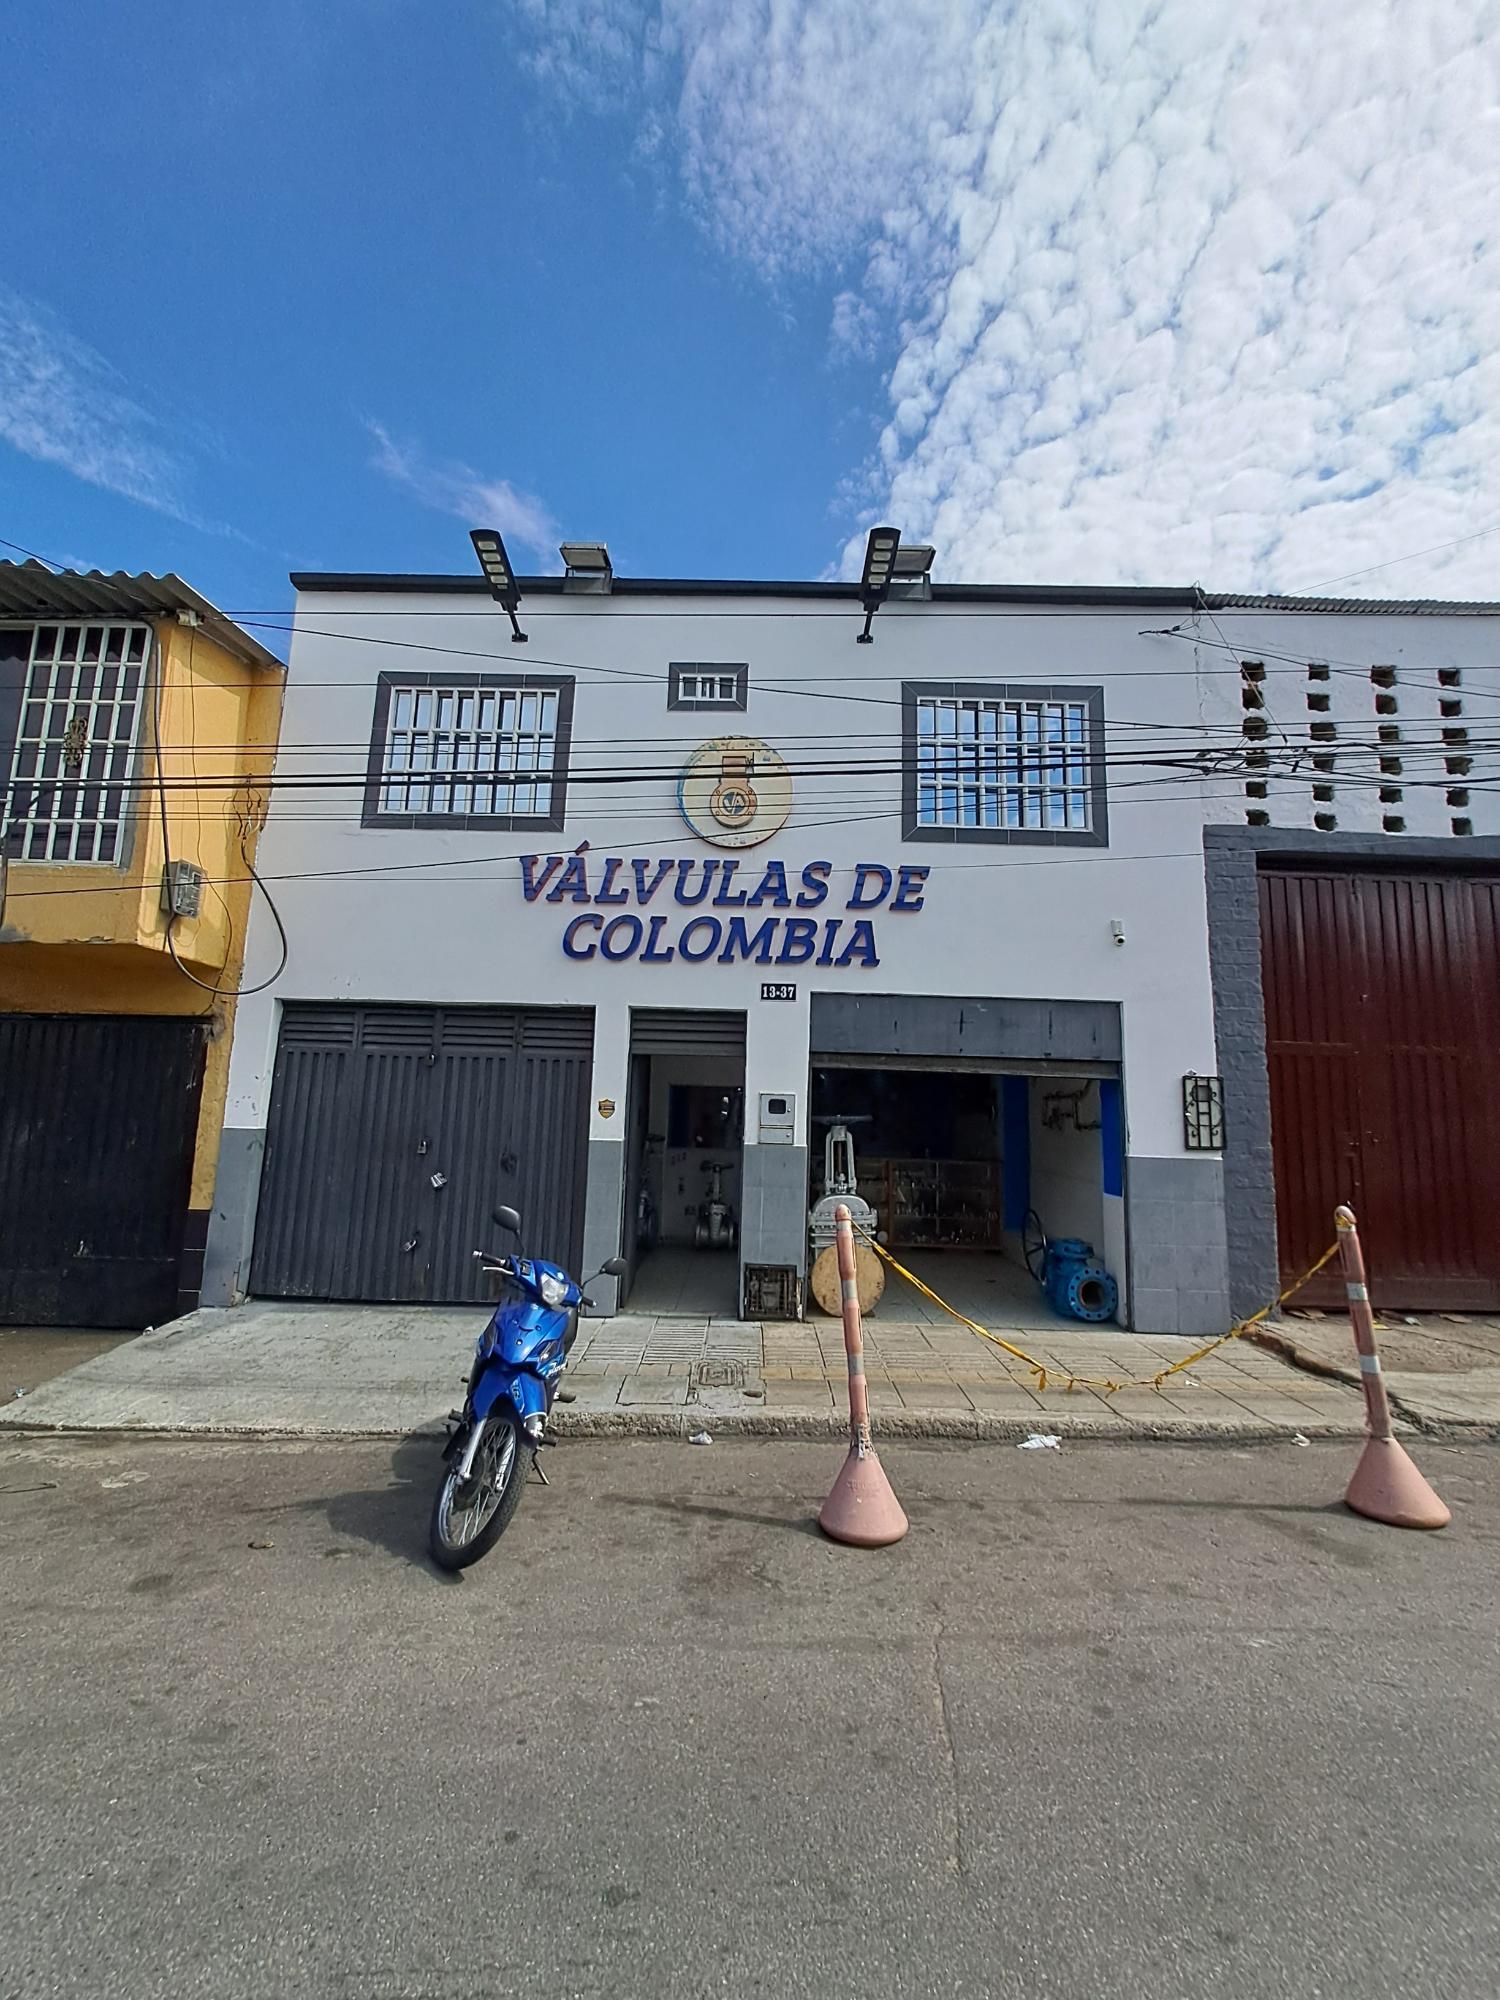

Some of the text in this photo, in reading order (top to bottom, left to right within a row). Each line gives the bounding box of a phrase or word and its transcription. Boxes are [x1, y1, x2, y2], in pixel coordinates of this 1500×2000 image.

[519, 840, 931, 912] VÁLVULAS DE
[562, 912, 880, 968] COLOMBIA
[762, 985, 795, 999] 13-37
